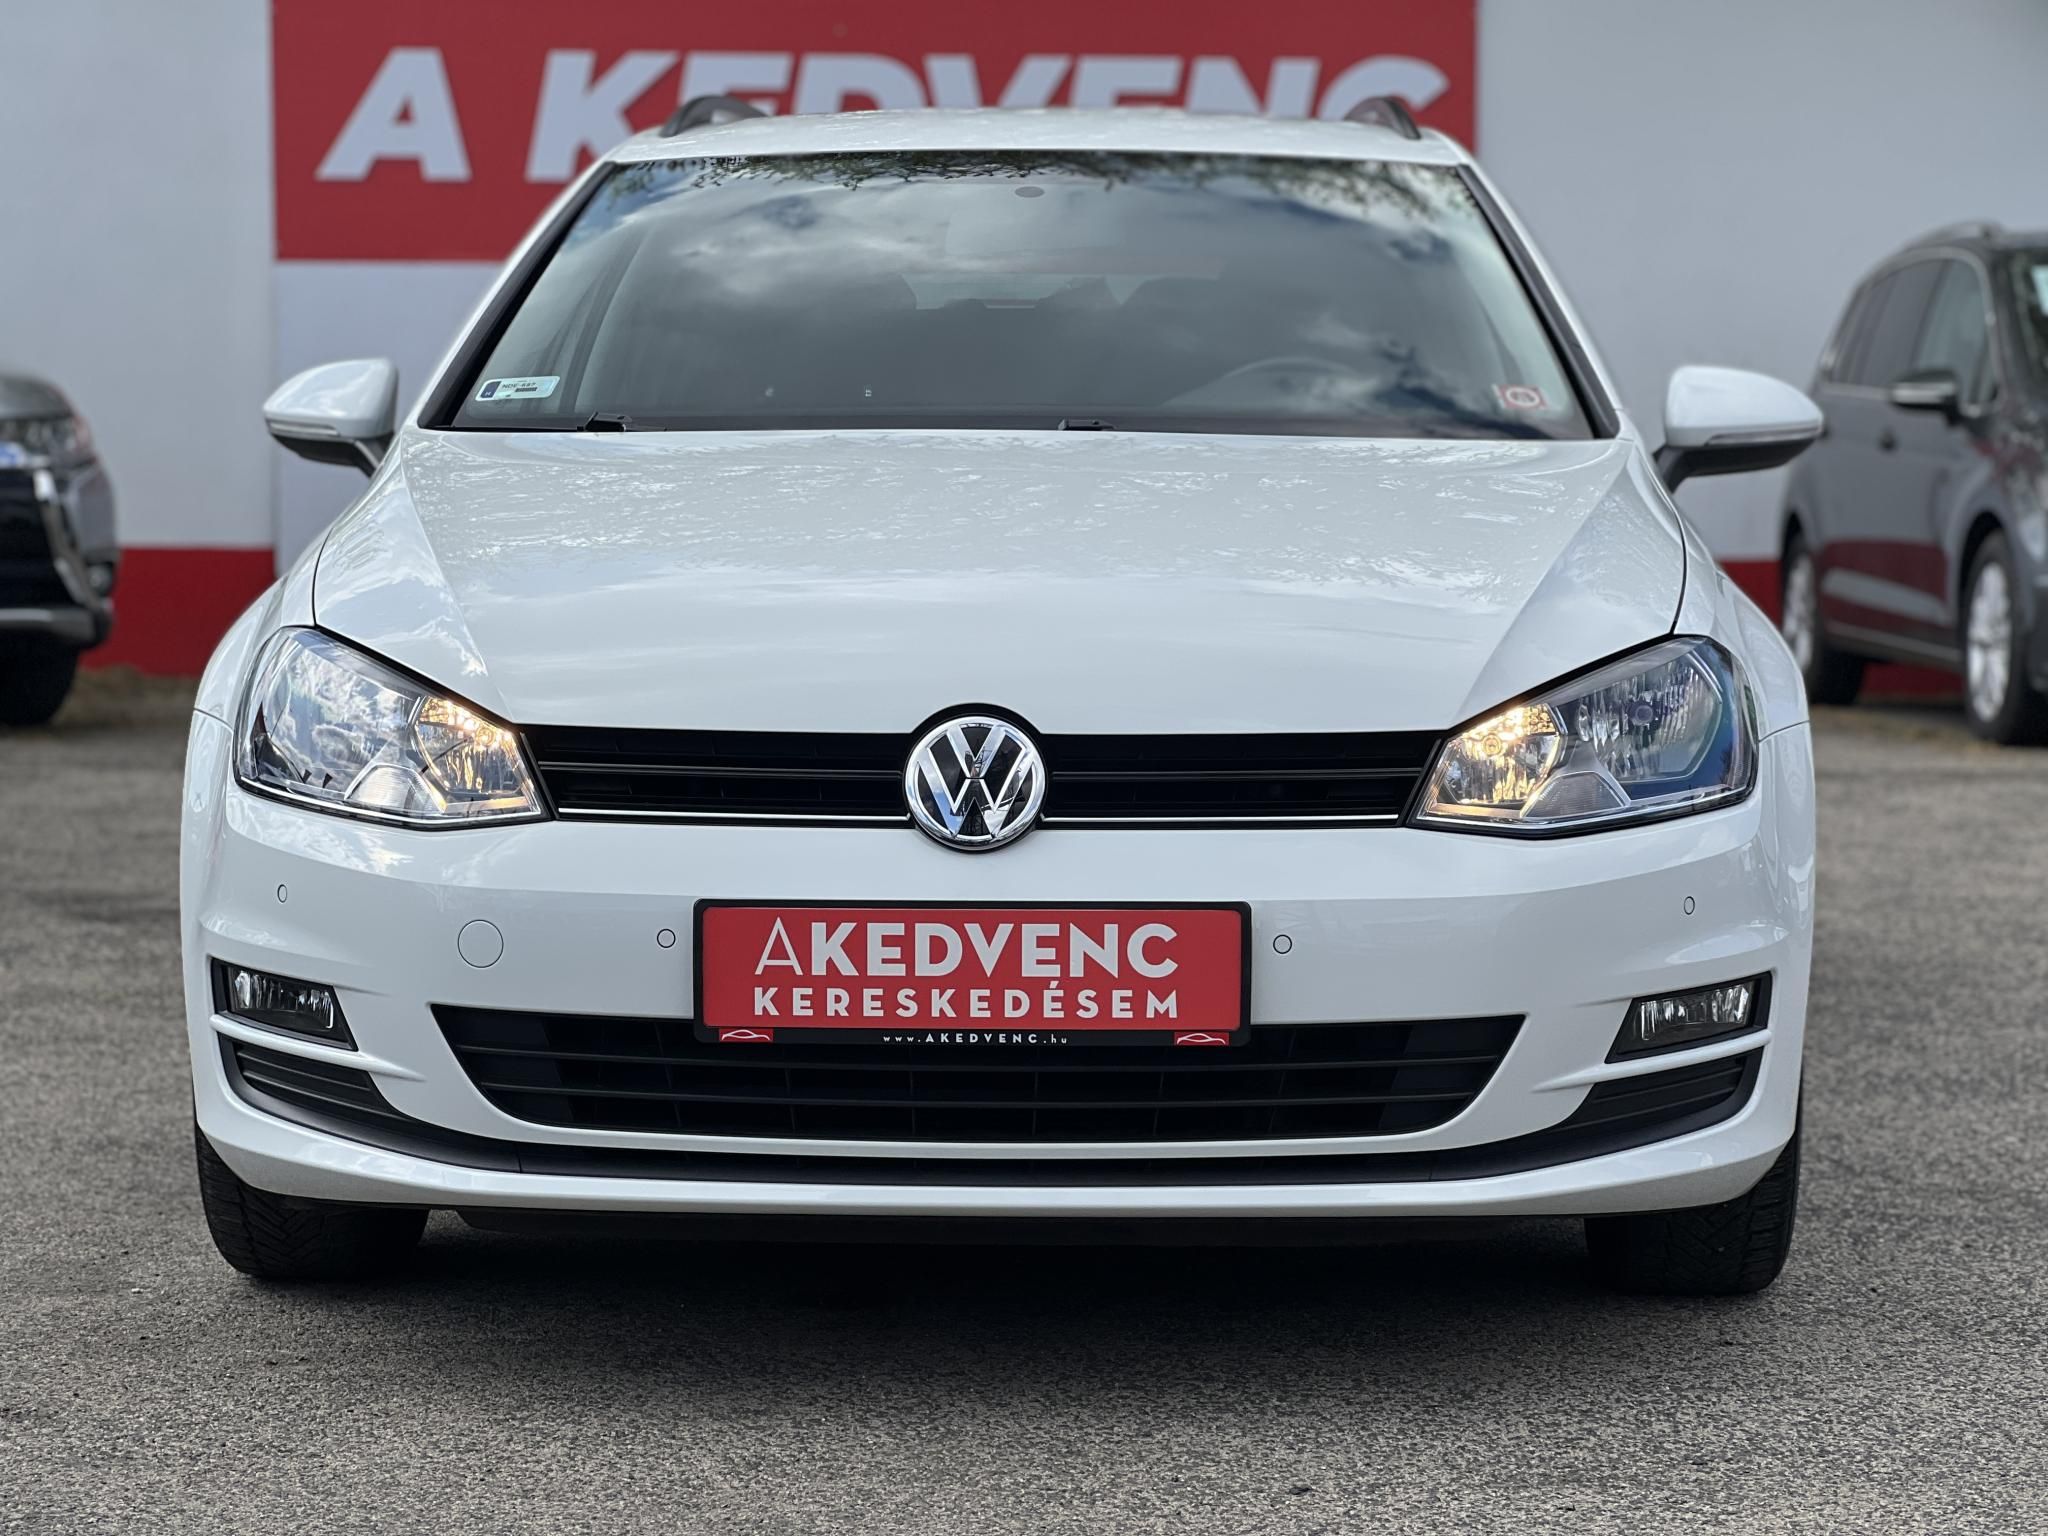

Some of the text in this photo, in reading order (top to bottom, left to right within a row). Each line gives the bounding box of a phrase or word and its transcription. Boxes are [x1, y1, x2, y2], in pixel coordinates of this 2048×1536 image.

[315, 46, 471, 182] A
[909, 719, 1041, 845] VW
[754, 981, 1178, 1019] KERESKEDÉSEM
[883, 1033, 1067, 1045] www.AKEDVENC.hu
